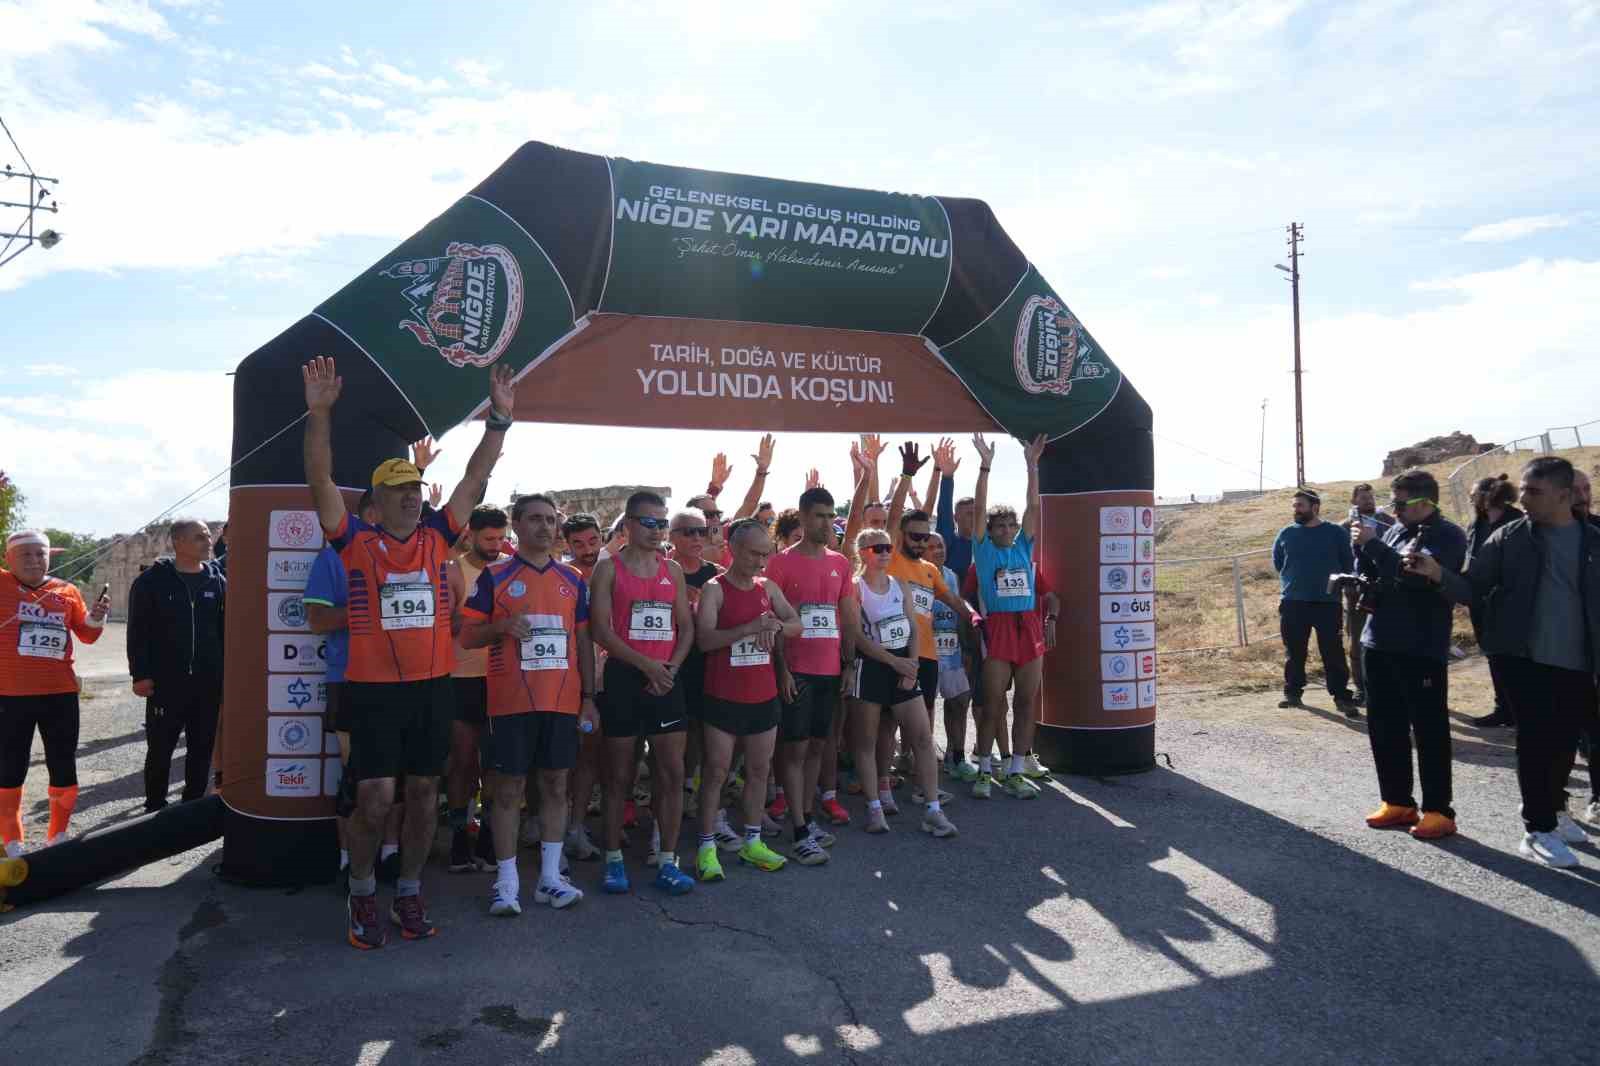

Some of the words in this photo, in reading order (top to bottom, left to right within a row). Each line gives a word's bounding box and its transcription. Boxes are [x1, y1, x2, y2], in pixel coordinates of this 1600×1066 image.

[650, 185, 773, 213] GELENEKSEL
[777, 202, 842, 224] DOĞUŞ
[846, 211, 921, 231] HOLDİNG
[616, 197, 715, 231] NİĞDE
[722, 211, 788, 240] YARI
[794, 222, 948, 258] MARATONU
[461, 261, 485, 347] NİĞDE
[650, 342, 714, 367] TARİH,
[721, 346, 776, 367] DOĞA
[781, 351, 806, 369] VE
[811, 351, 881, 373] KÜLTÜR
[636, 368, 783, 399] YOLUNDA
[791, 375, 894, 408] KOŞUN!
[1003, 578, 1025, 588] 133
[391, 599, 427, 615] 194
[644, 615, 663, 628] 83
[812, 616, 829, 627] 53
[29, 634, 60, 648] 125
[534, 643, 557, 656] 94
